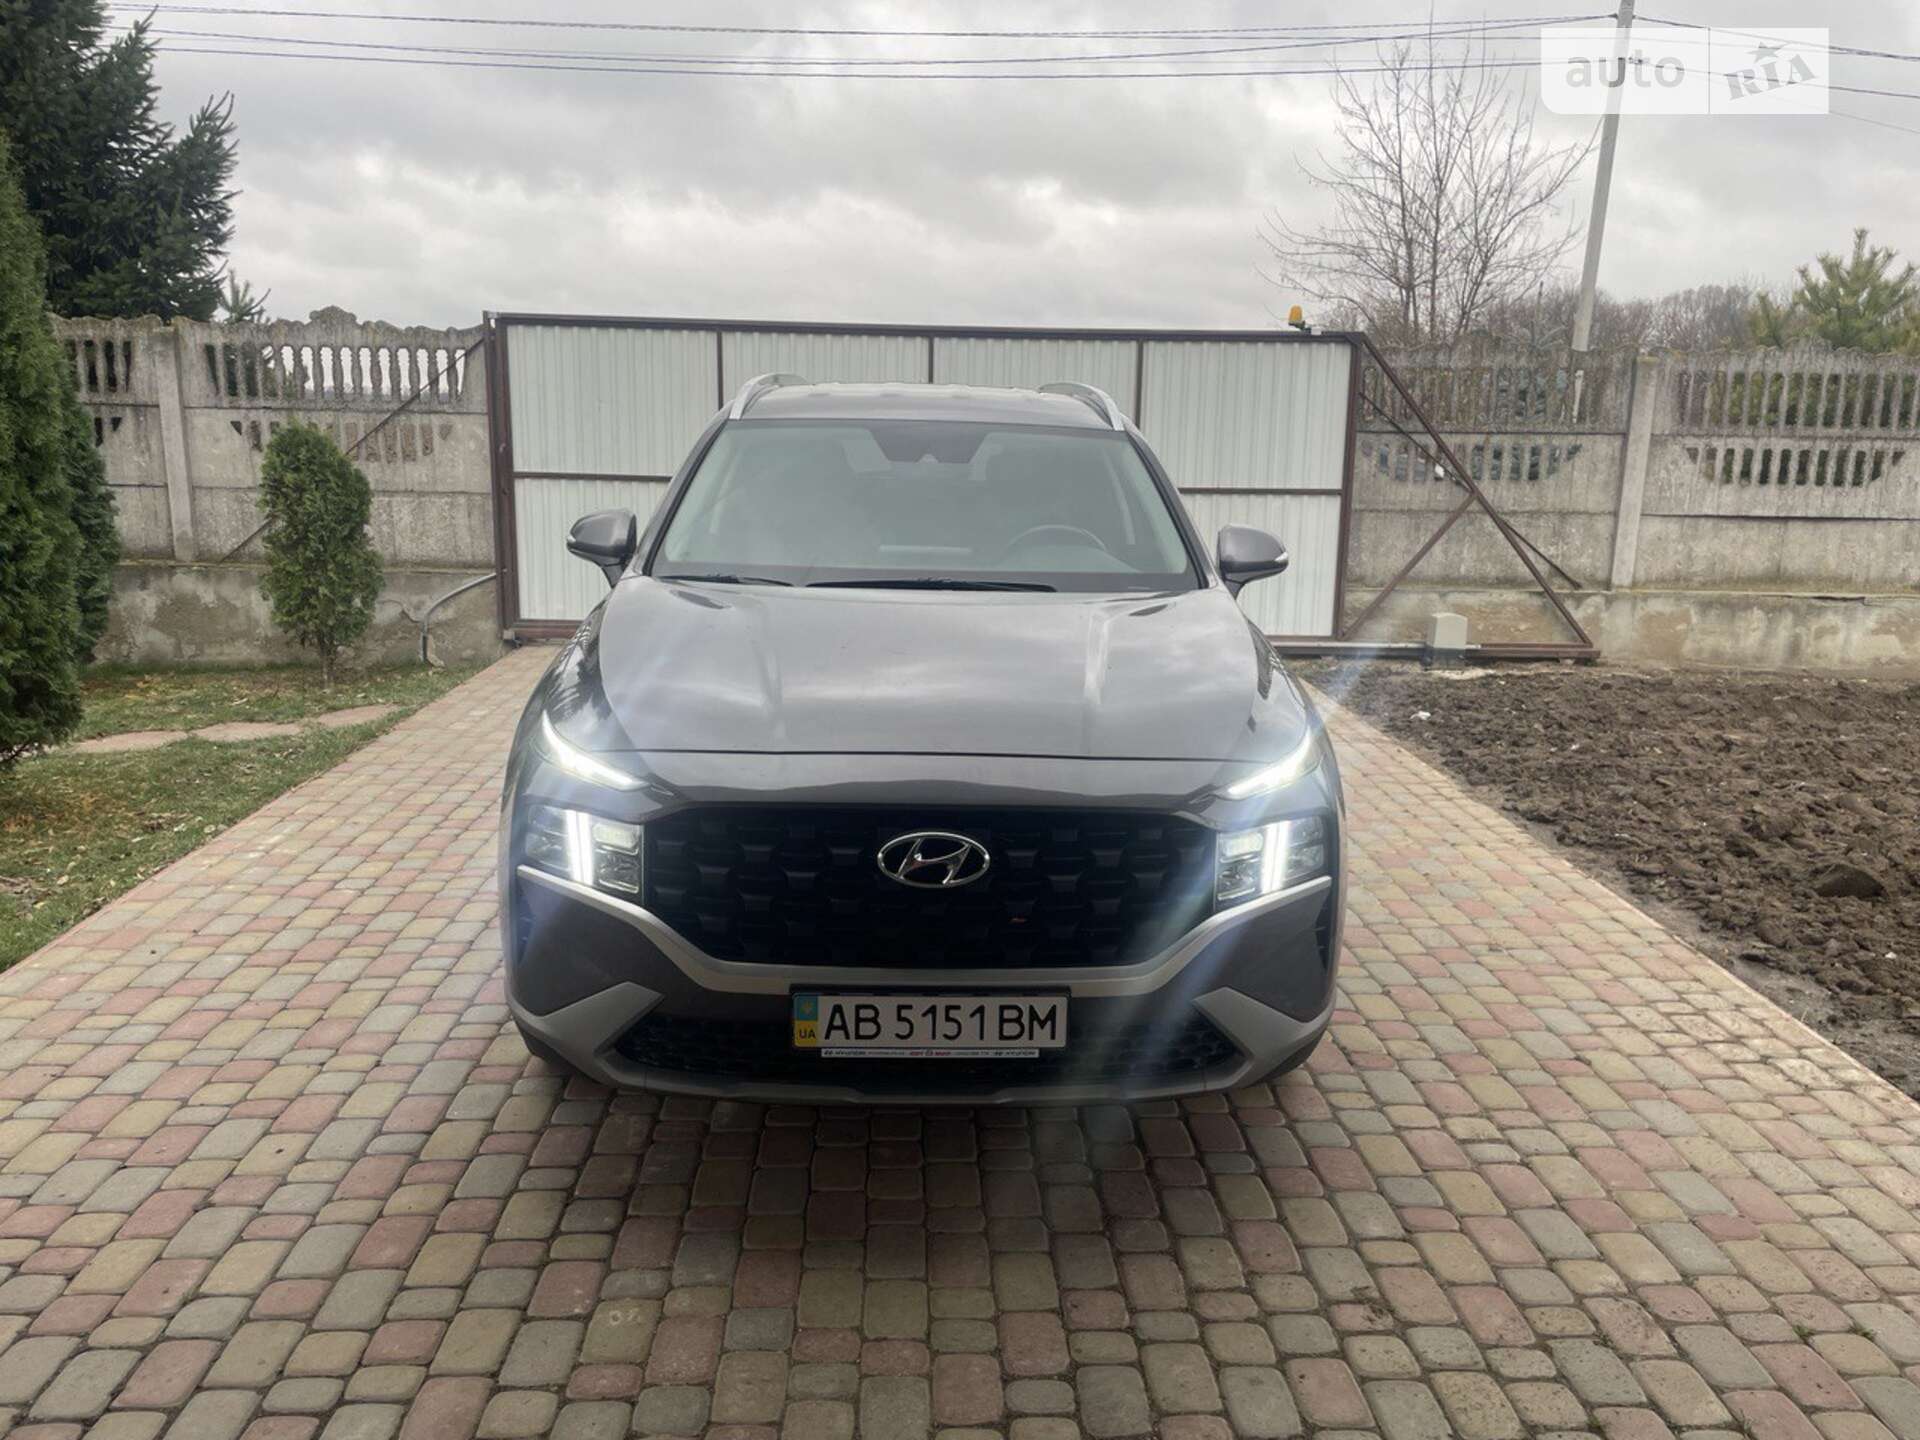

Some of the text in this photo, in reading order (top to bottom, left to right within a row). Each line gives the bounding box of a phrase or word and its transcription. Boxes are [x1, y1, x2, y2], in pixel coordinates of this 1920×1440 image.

[798, 1029, 816, 1039] UA
[824, 1004, 1057, 1041] AB 5151 BM
